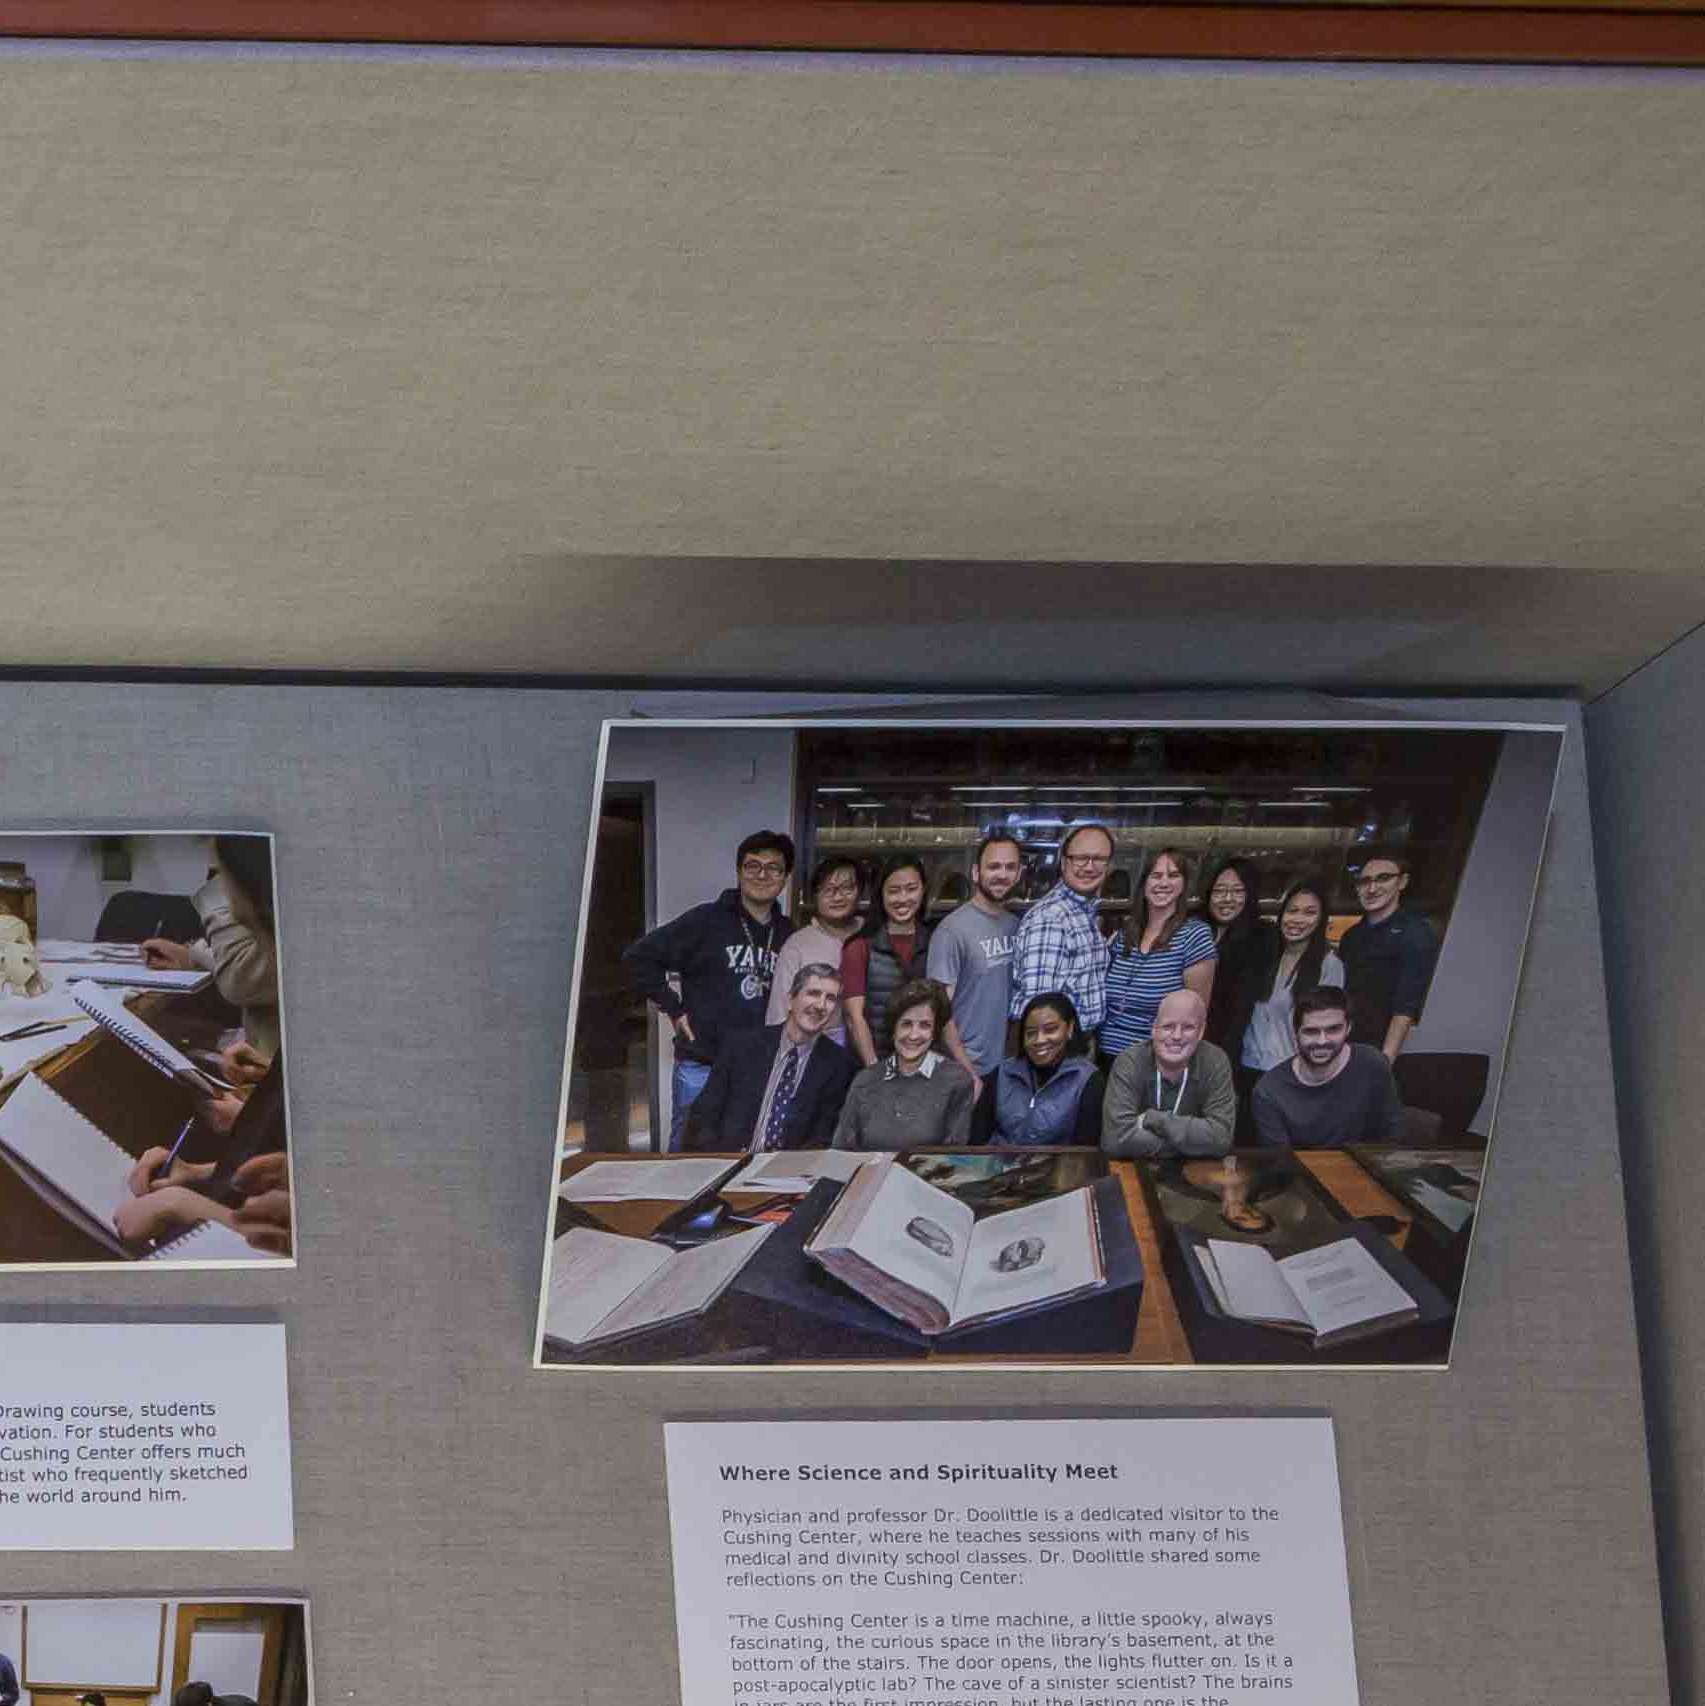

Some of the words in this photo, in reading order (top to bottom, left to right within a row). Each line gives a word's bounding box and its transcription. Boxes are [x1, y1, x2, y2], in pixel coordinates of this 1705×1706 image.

[70, 1405, 133, 1419] course,
[140, 1401, 216, 1417] students
[719, 1465, 790, 1481] Where
[798, 1464, 881, 1481] Science
[889, 1463, 929, 1480] and
[937, 1463, 1057, 1483] Spirituality
[1065, 1463, 1117, 1479] Meet
[721, 1509, 802, 1526] Physician
[808, 1507, 840, 1523] and
[846, 1507, 928, 1526] professor
[933, 1508, 960, 1522] Dr.
[967, 1507, 1038, 1522] Doolittle
[1044, 1508, 1058, 1522] is
[1064, 1509, 1074, 1522] a
[1080, 1506, 1163, 1522] dedicated
[1170, 1507, 1224, 1521] visitor
[1228, 1507, 1245, 1520] to
[1251, 1506, 1279, 1521] the
